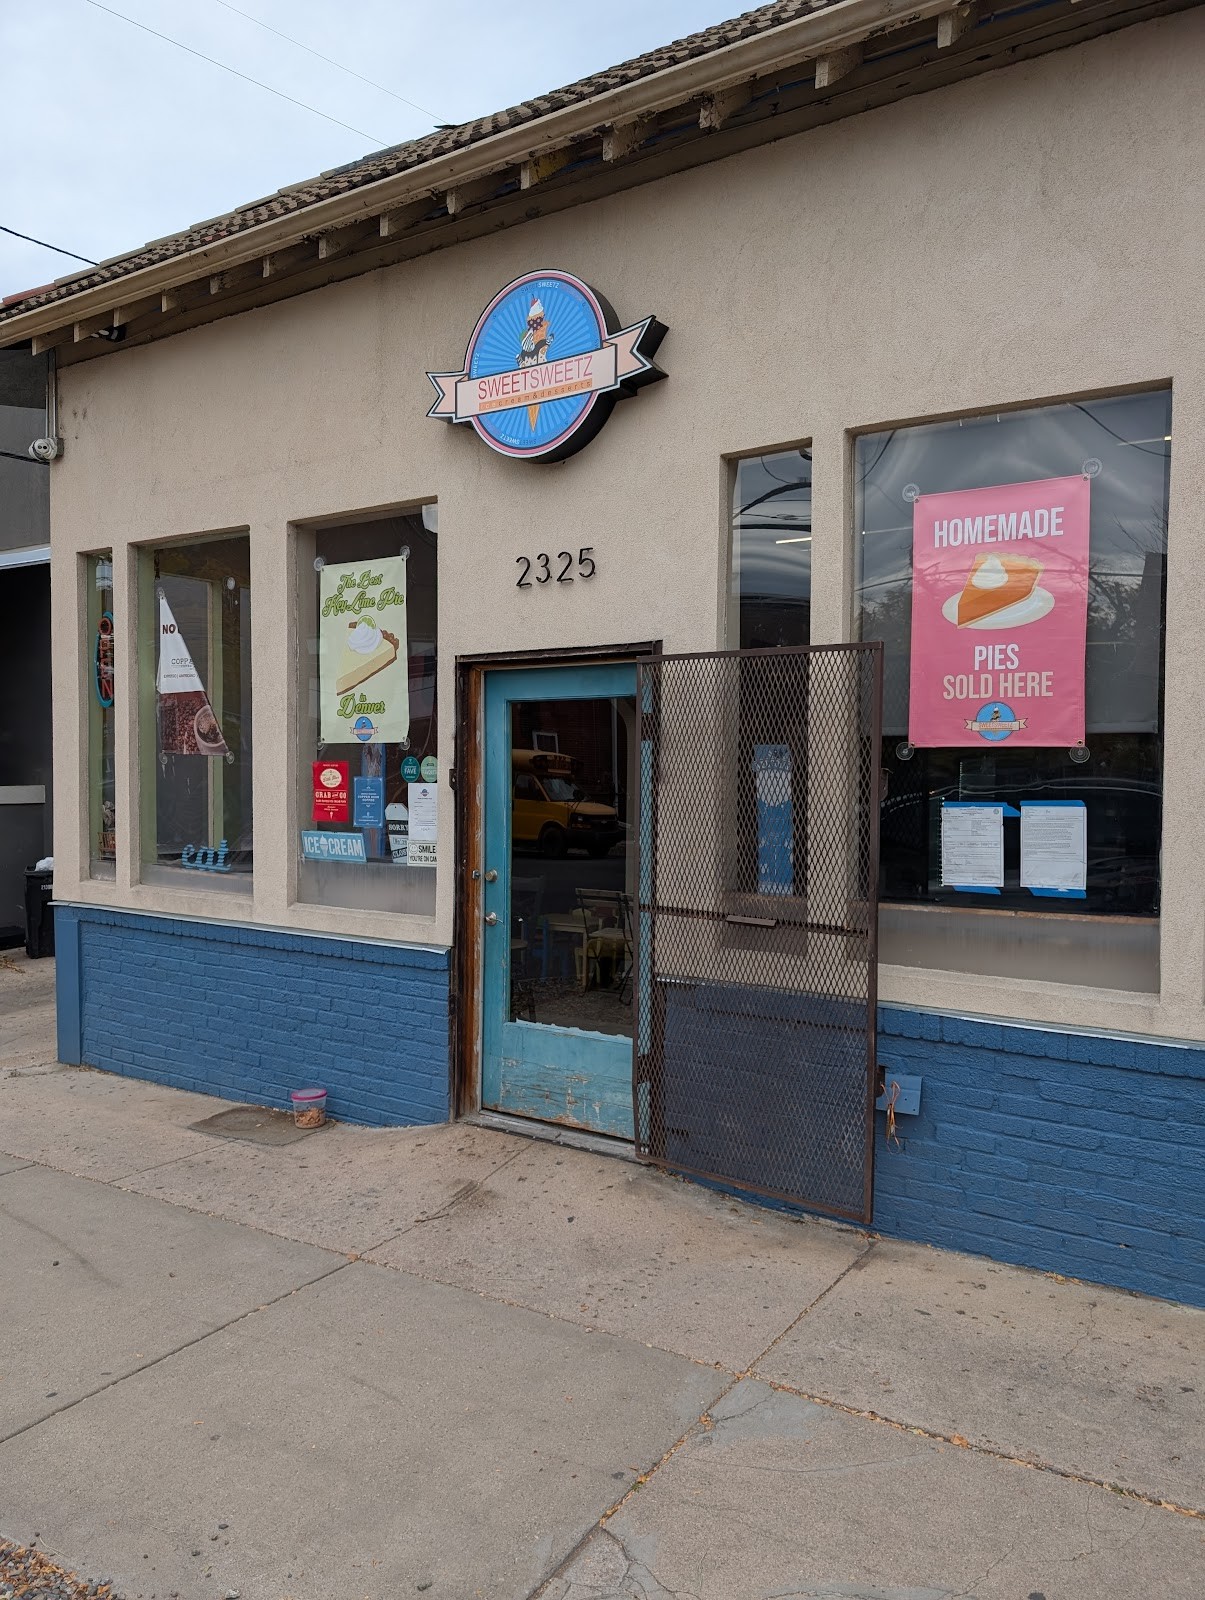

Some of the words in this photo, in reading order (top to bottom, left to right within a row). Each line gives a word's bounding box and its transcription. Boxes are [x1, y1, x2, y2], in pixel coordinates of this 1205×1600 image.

[478, 355, 593, 400] SWEETSWEETZ
[934, 506, 1065, 548] HOMEMADE
[515, 547, 596, 588] 2325
[337, 572, 357, 594] The
[357, 570, 384, 589] Best
[322, 593, 348, 617] Key
[346, 590, 376, 615] Lime
[376, 586, 405, 611] Pie
[162, 623, 177, 635] NO
[974, 644, 1020, 671] PIES
[359, 692, 367, 702] in
[942, 673, 993, 700] SOLD
[1000, 671, 1054, 698] HERE
[336, 692, 386, 719] Denver
[315, 791, 331, 799] GRAB
[339, 791, 347, 799] GO
[303, 836, 320, 853] ICE
[327, 837, 363, 857] CREAM
[418, 845, 437, 854] SMILE
